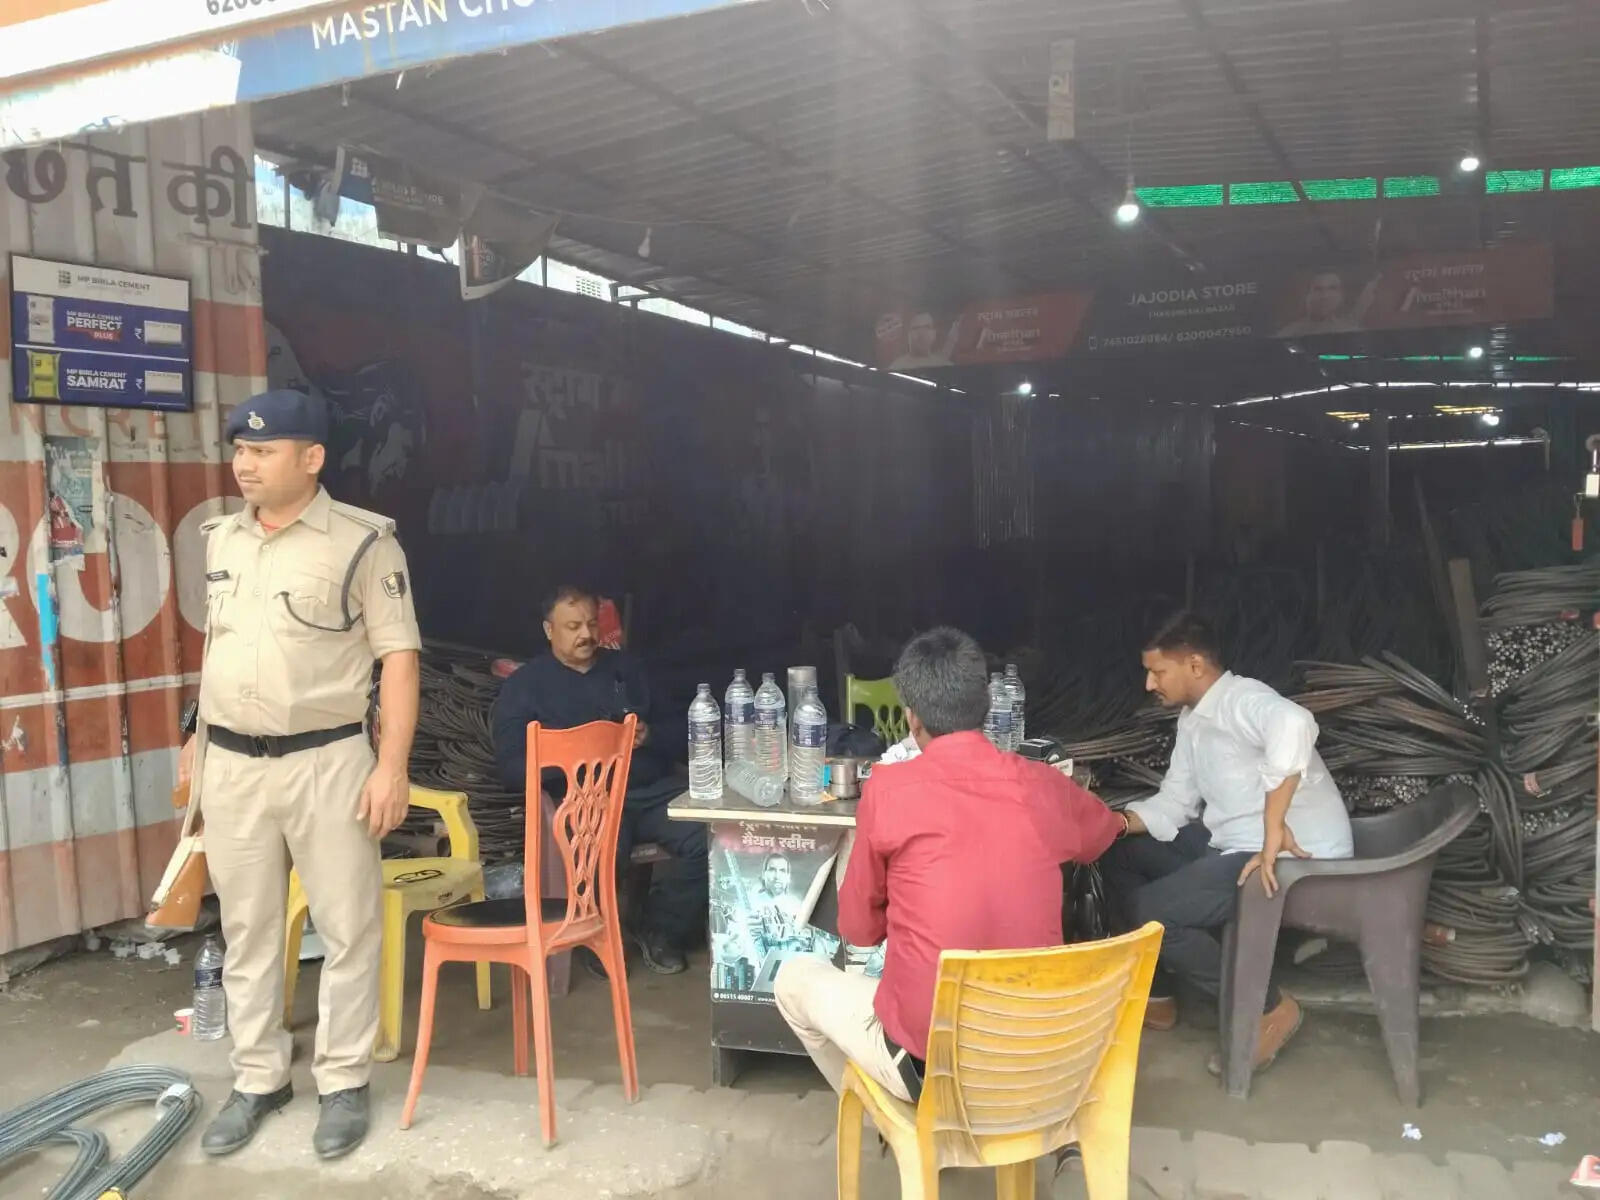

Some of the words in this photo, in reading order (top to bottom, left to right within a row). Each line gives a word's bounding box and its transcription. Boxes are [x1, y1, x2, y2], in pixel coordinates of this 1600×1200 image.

[311, 0, 448, 49] MASTAN
[118, 280, 151, 291] CEMENT
[1127, 288, 1198, 305] JAJODIA
[1201, 282, 1257, 298] STORE
[67, 316, 123, 331] PERFECT
[67, 375, 127, 390] SAMRAT
